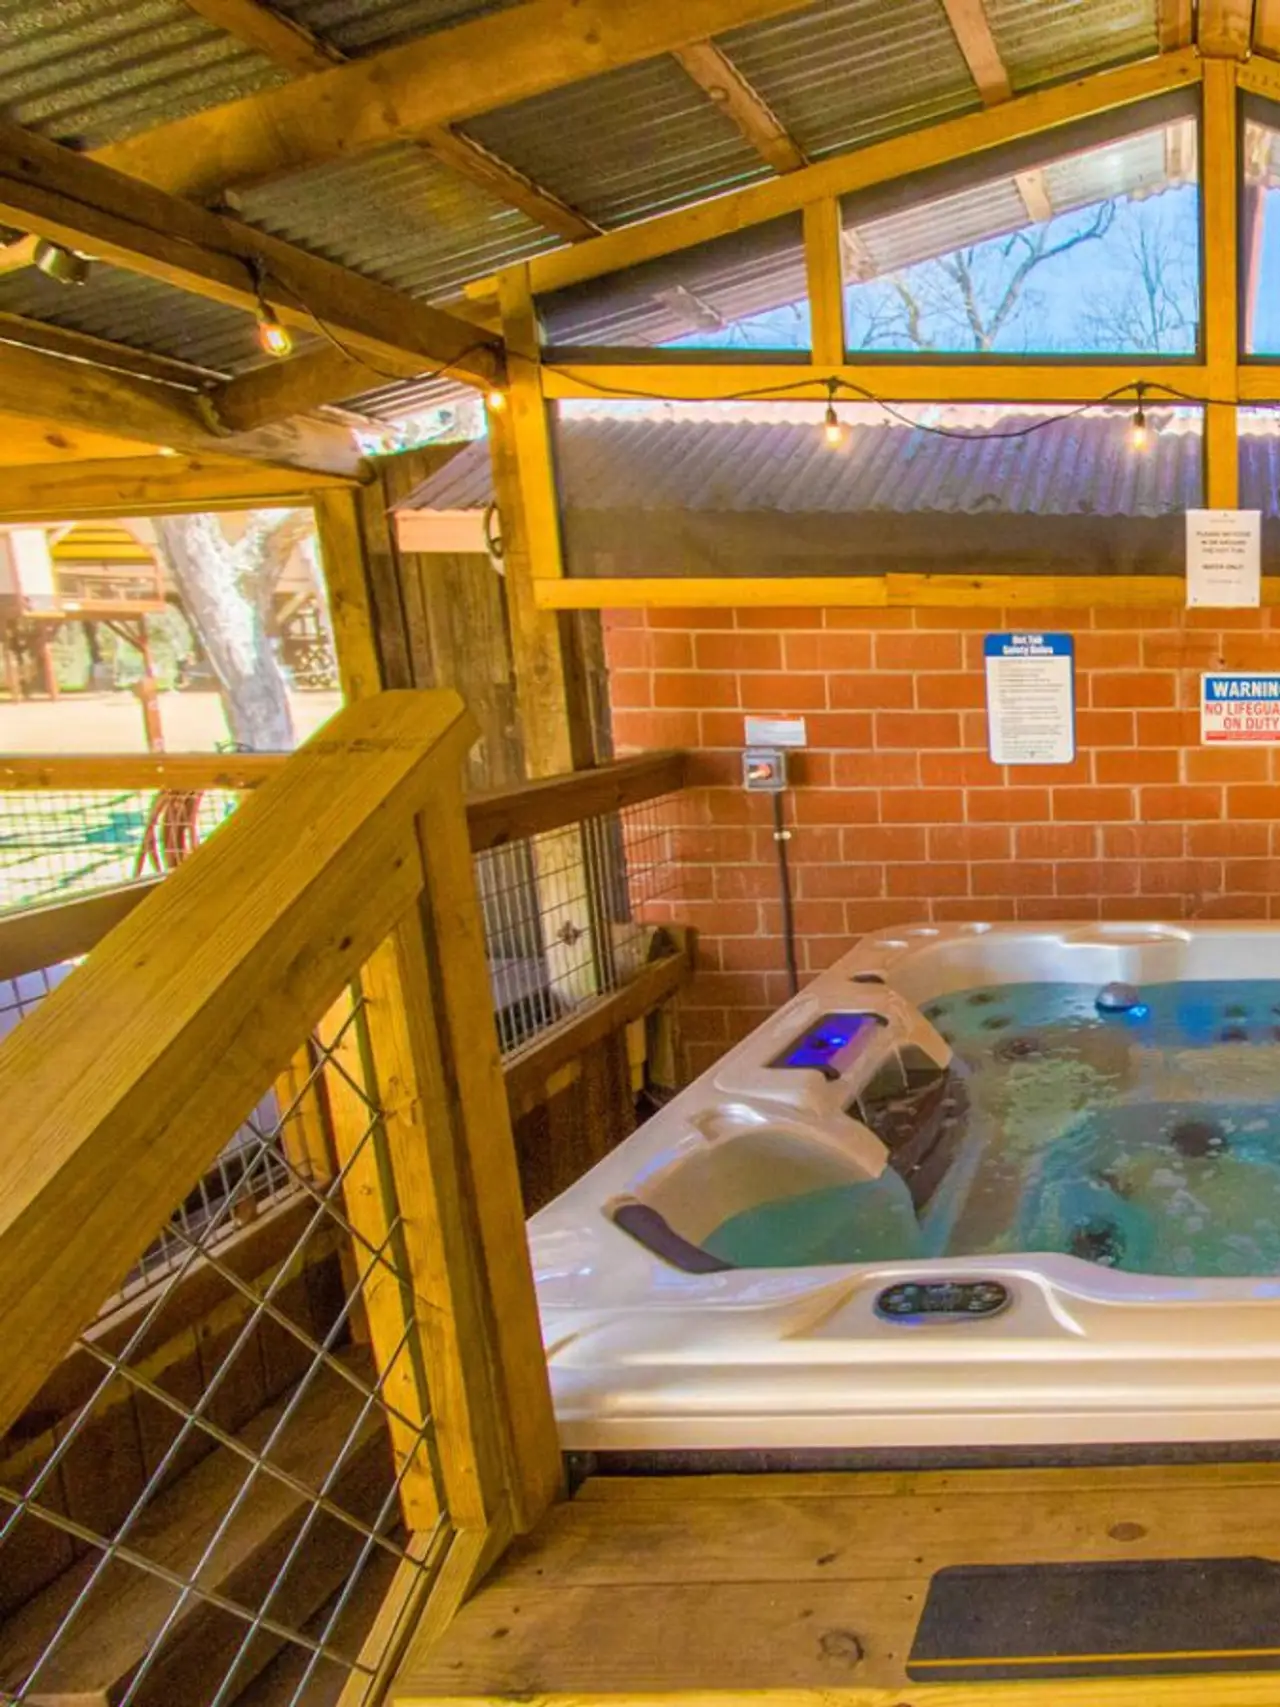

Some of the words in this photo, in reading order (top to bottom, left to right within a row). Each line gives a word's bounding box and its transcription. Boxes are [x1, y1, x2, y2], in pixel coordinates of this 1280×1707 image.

[1205, 702, 1223, 716] NO
[1223, 717, 1241, 730] ON
[1246, 717, 1280, 730] DUTY
